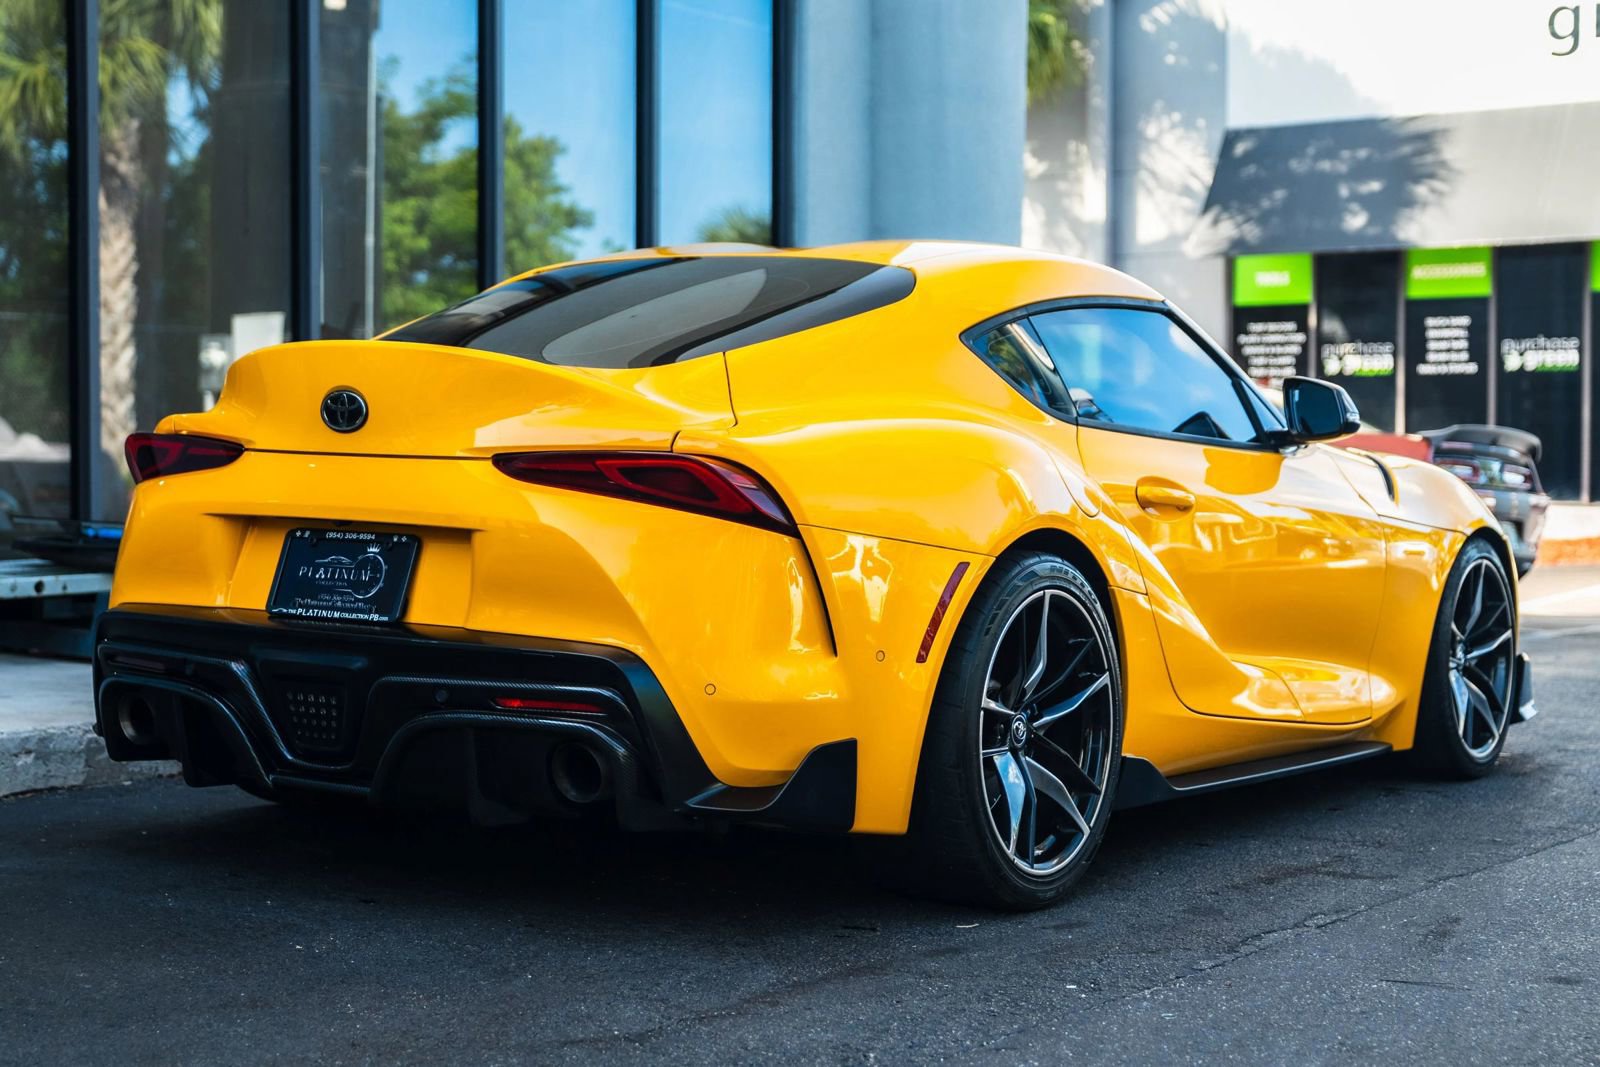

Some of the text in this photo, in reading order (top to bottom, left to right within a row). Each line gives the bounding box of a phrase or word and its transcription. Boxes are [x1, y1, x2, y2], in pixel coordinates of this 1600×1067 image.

[1548, 3, 1600, 56] g
[325, 531, 375, 540] (954) 306-9594
[1049, 564, 1098, 605] NITTO
